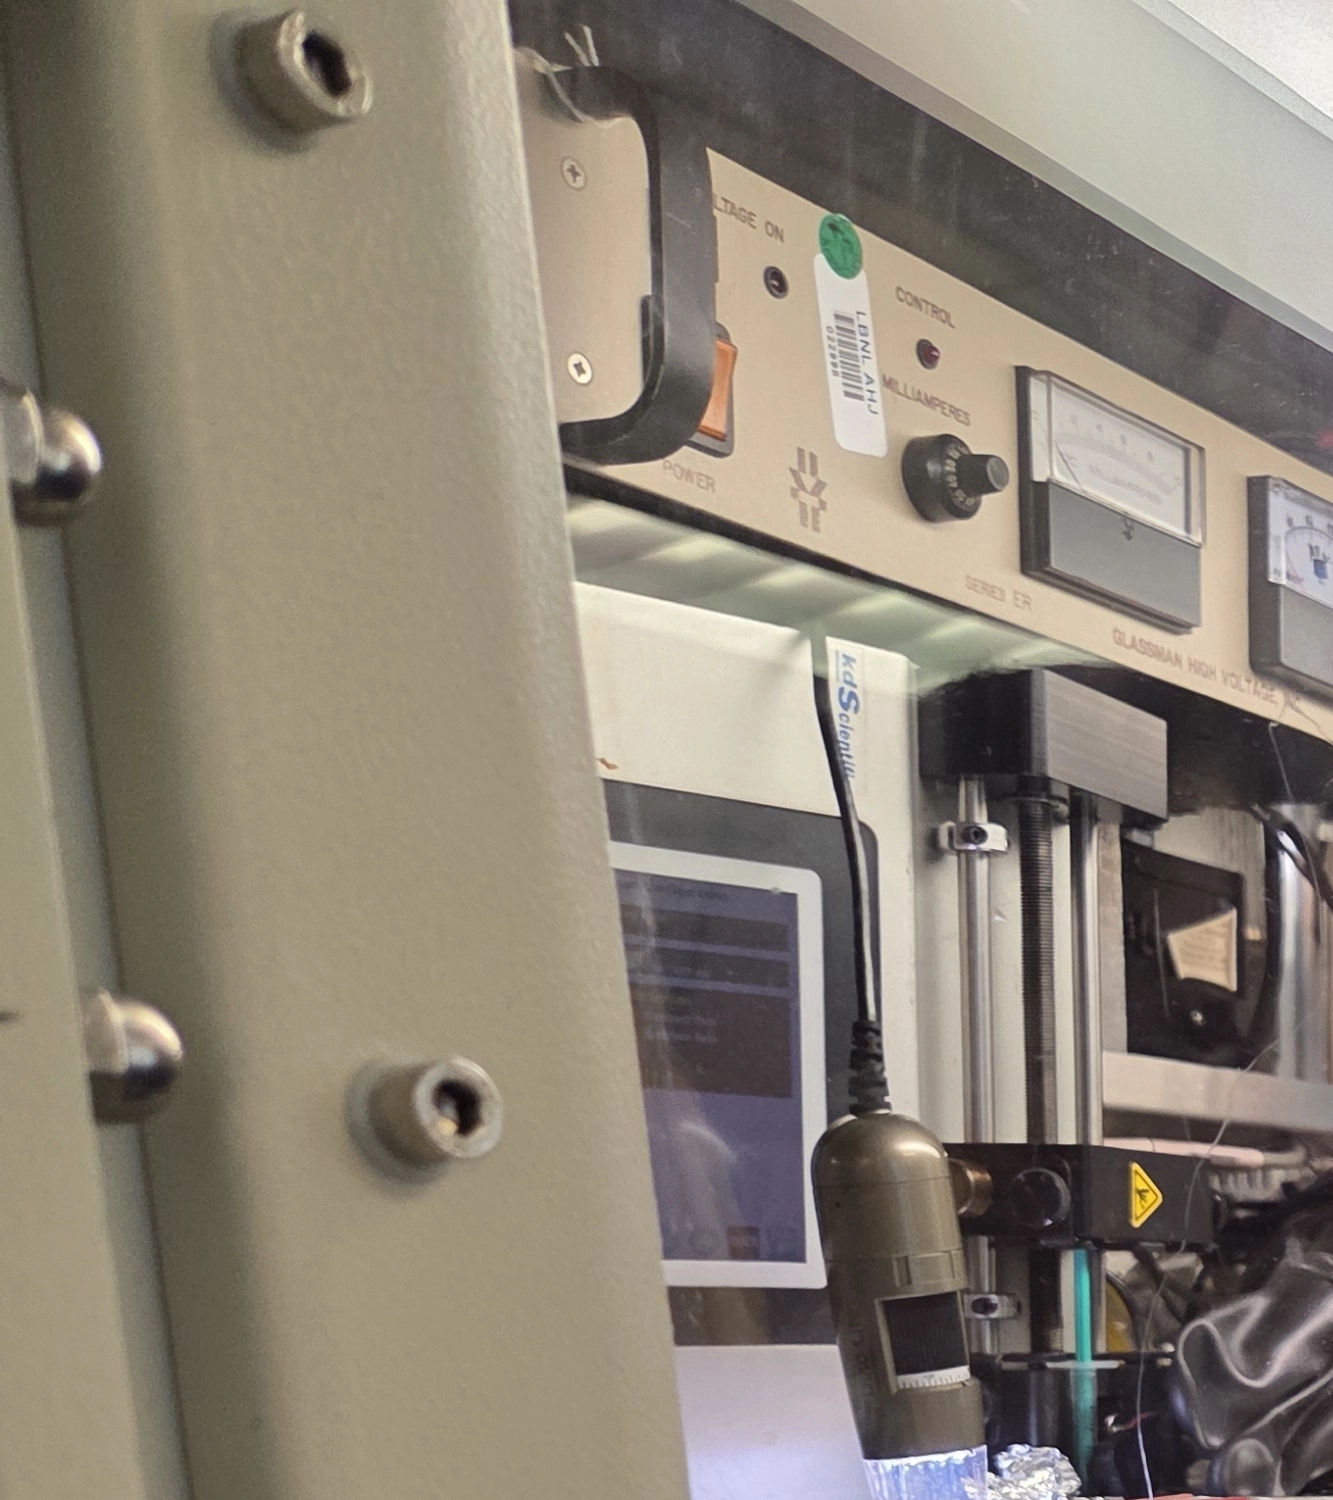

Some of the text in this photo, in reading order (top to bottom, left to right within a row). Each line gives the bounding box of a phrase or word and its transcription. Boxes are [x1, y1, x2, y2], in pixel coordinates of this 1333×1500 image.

[712, 195, 786, 244] LTAGE ON
[895, 286, 956, 329] CONTROL
[855, 310, 879, 415] LBNL AHJ
[881, 373, 971, 427] MILLIAMPERES
[662, 459, 717, 494] POWER
[1012, 588, 1032, 611] ER
[1112, 627, 1184, 672] GLASSMAN
[1187, 656, 1218, 682] HIGH
[1221, 668, 1277, 704] VOLTAGE
